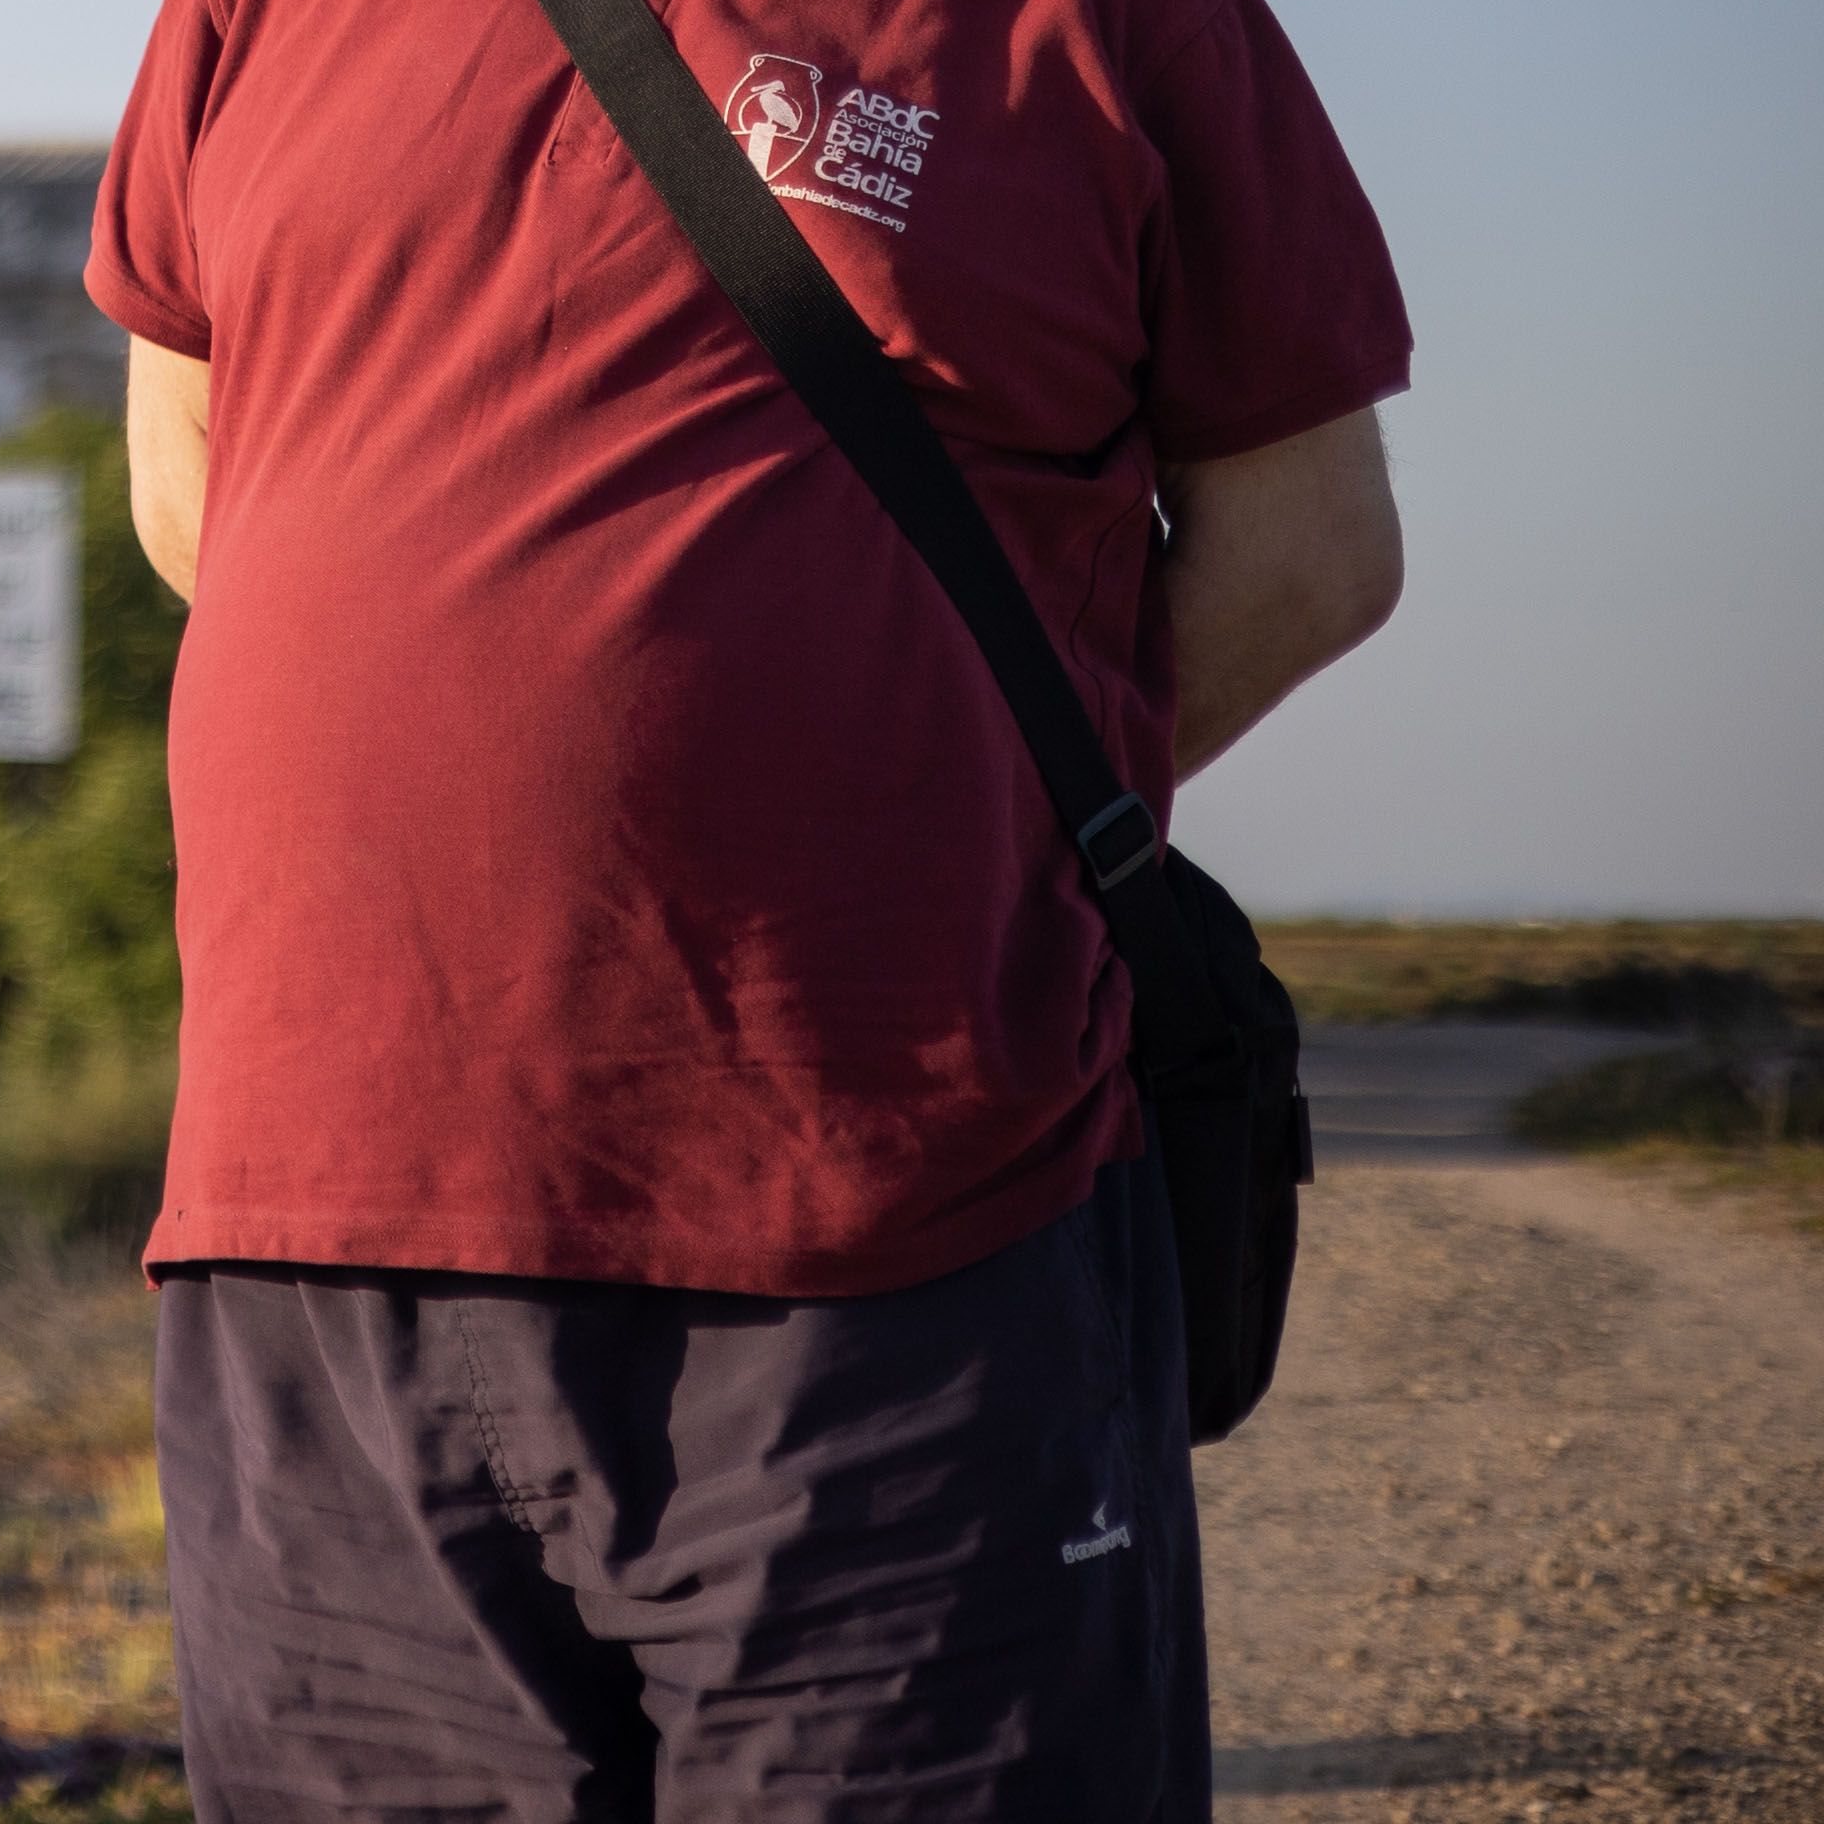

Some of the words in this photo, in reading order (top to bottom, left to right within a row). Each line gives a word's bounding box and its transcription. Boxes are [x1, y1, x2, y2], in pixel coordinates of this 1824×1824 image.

[835, 109, 927, 151] Asociación
[836, 88, 940, 139] ABdC
[823, 143, 847, 160] de
[825, 120, 923, 175] Bahía
[814, 155, 913, 209] Cádiz
